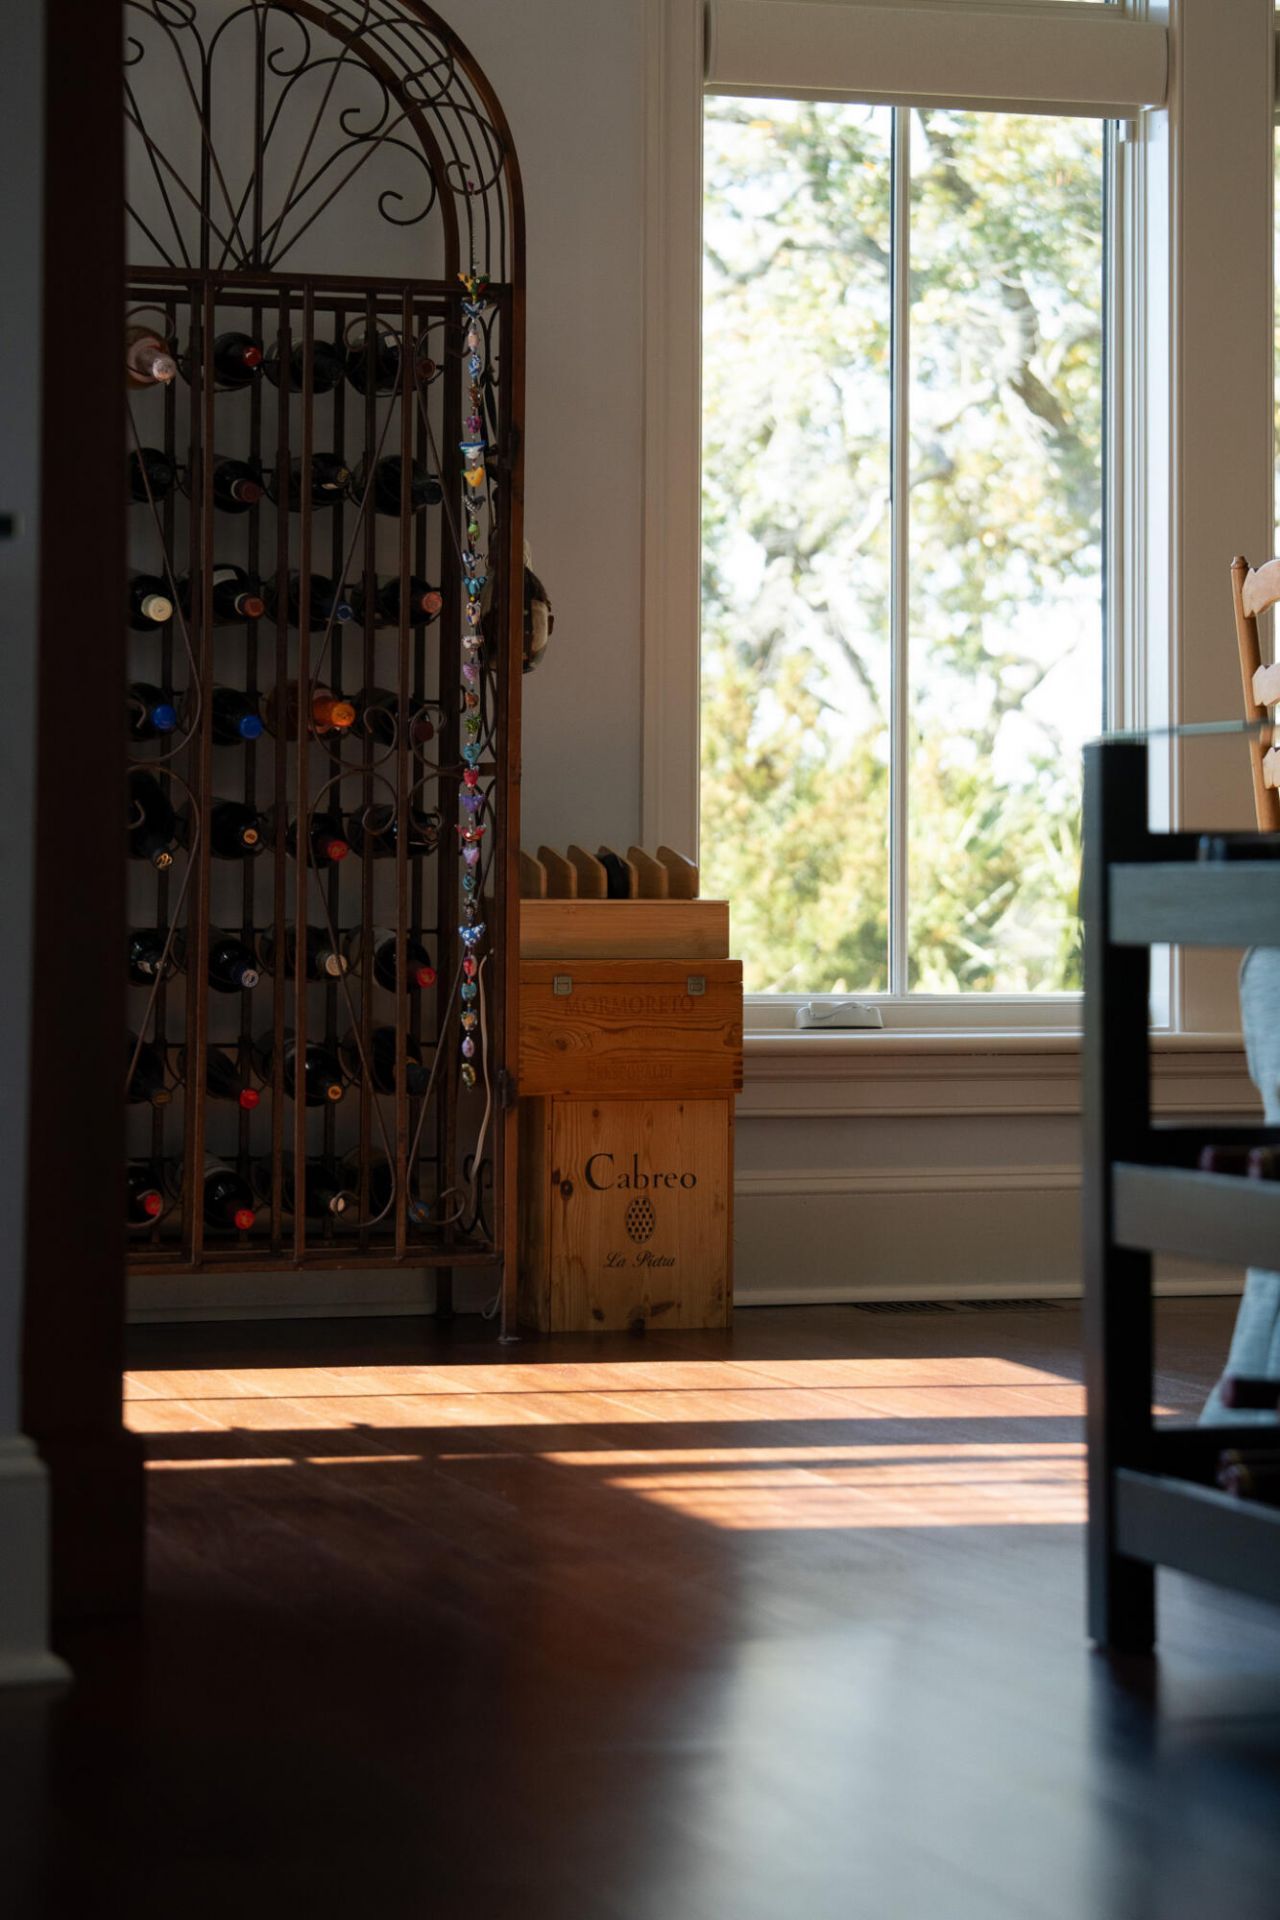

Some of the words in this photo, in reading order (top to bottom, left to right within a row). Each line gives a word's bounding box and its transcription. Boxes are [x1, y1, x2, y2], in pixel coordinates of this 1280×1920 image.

[564, 994, 696, 1015] MORMORETO
[585, 1153, 697, 1191] Cabreo
[603, 1251, 627, 1268] La
